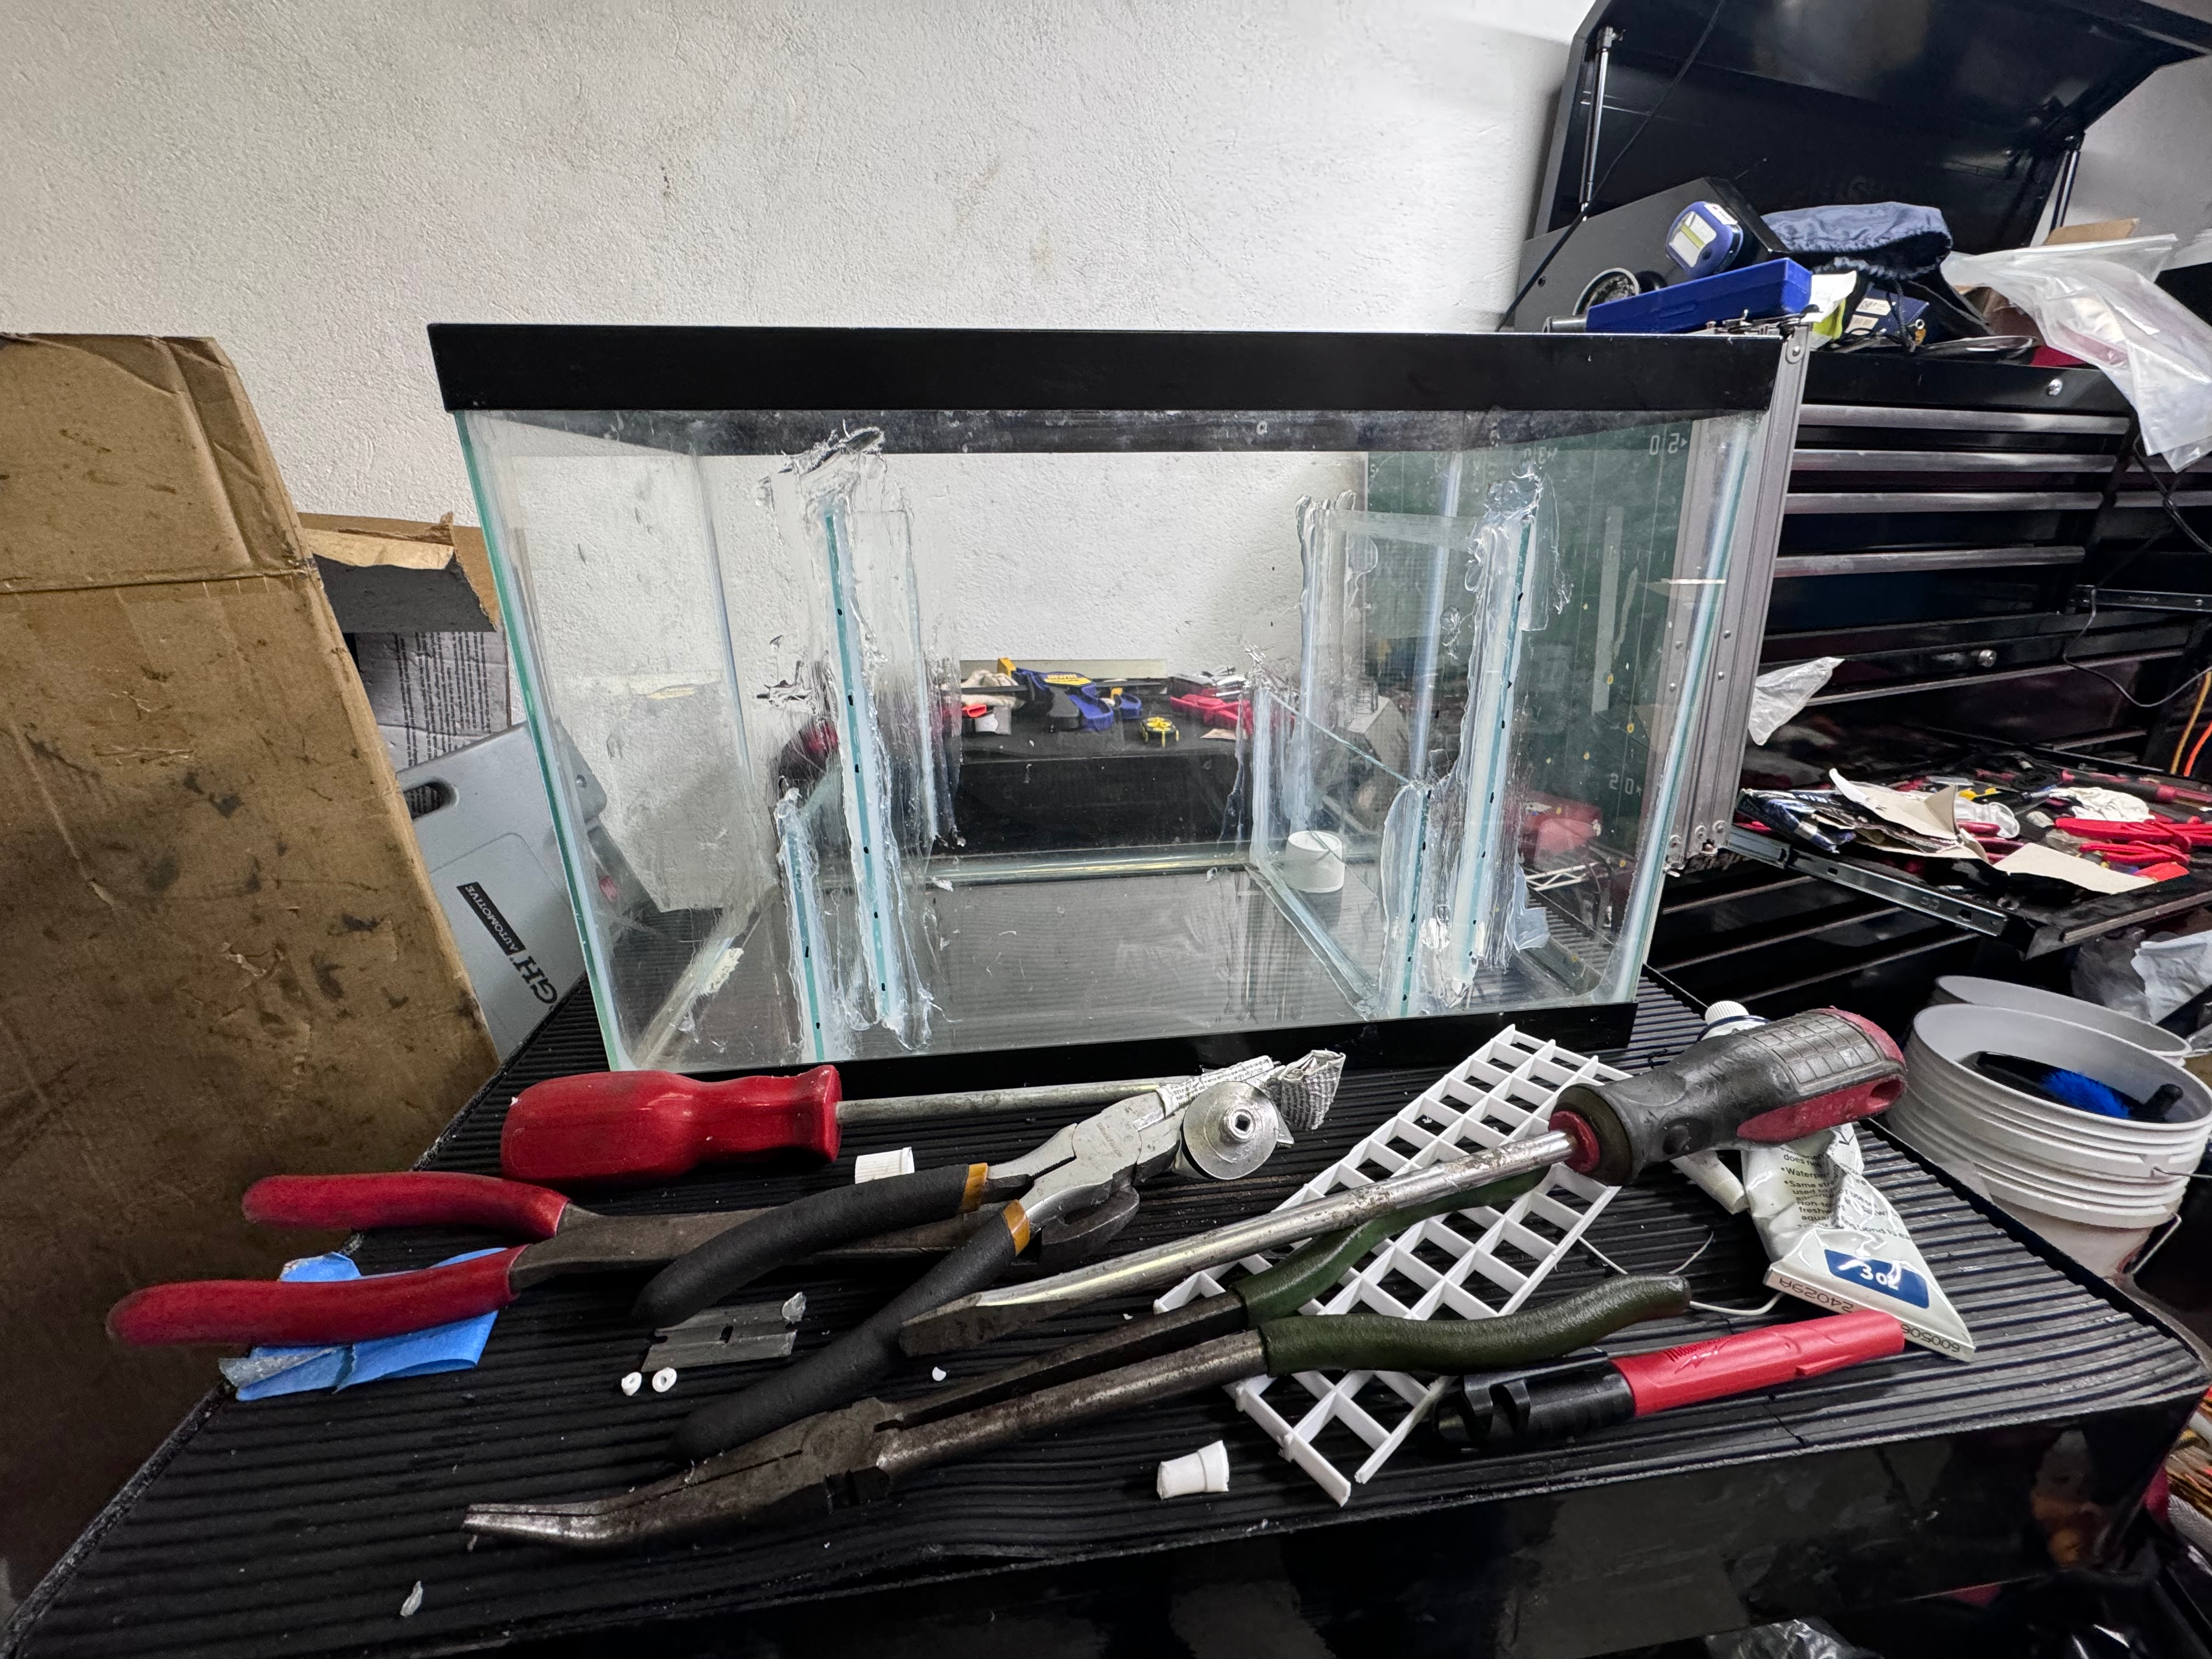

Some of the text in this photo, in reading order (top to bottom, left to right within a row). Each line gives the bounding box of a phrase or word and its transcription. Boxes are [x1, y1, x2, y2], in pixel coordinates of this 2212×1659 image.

[465, 885, 518, 951] AUTOMOTIVE
[1783, 1153, 1805, 1164] does
[1789, 1180, 1816, 1188] Same
[1859, 1262, 1875, 1280] 3
